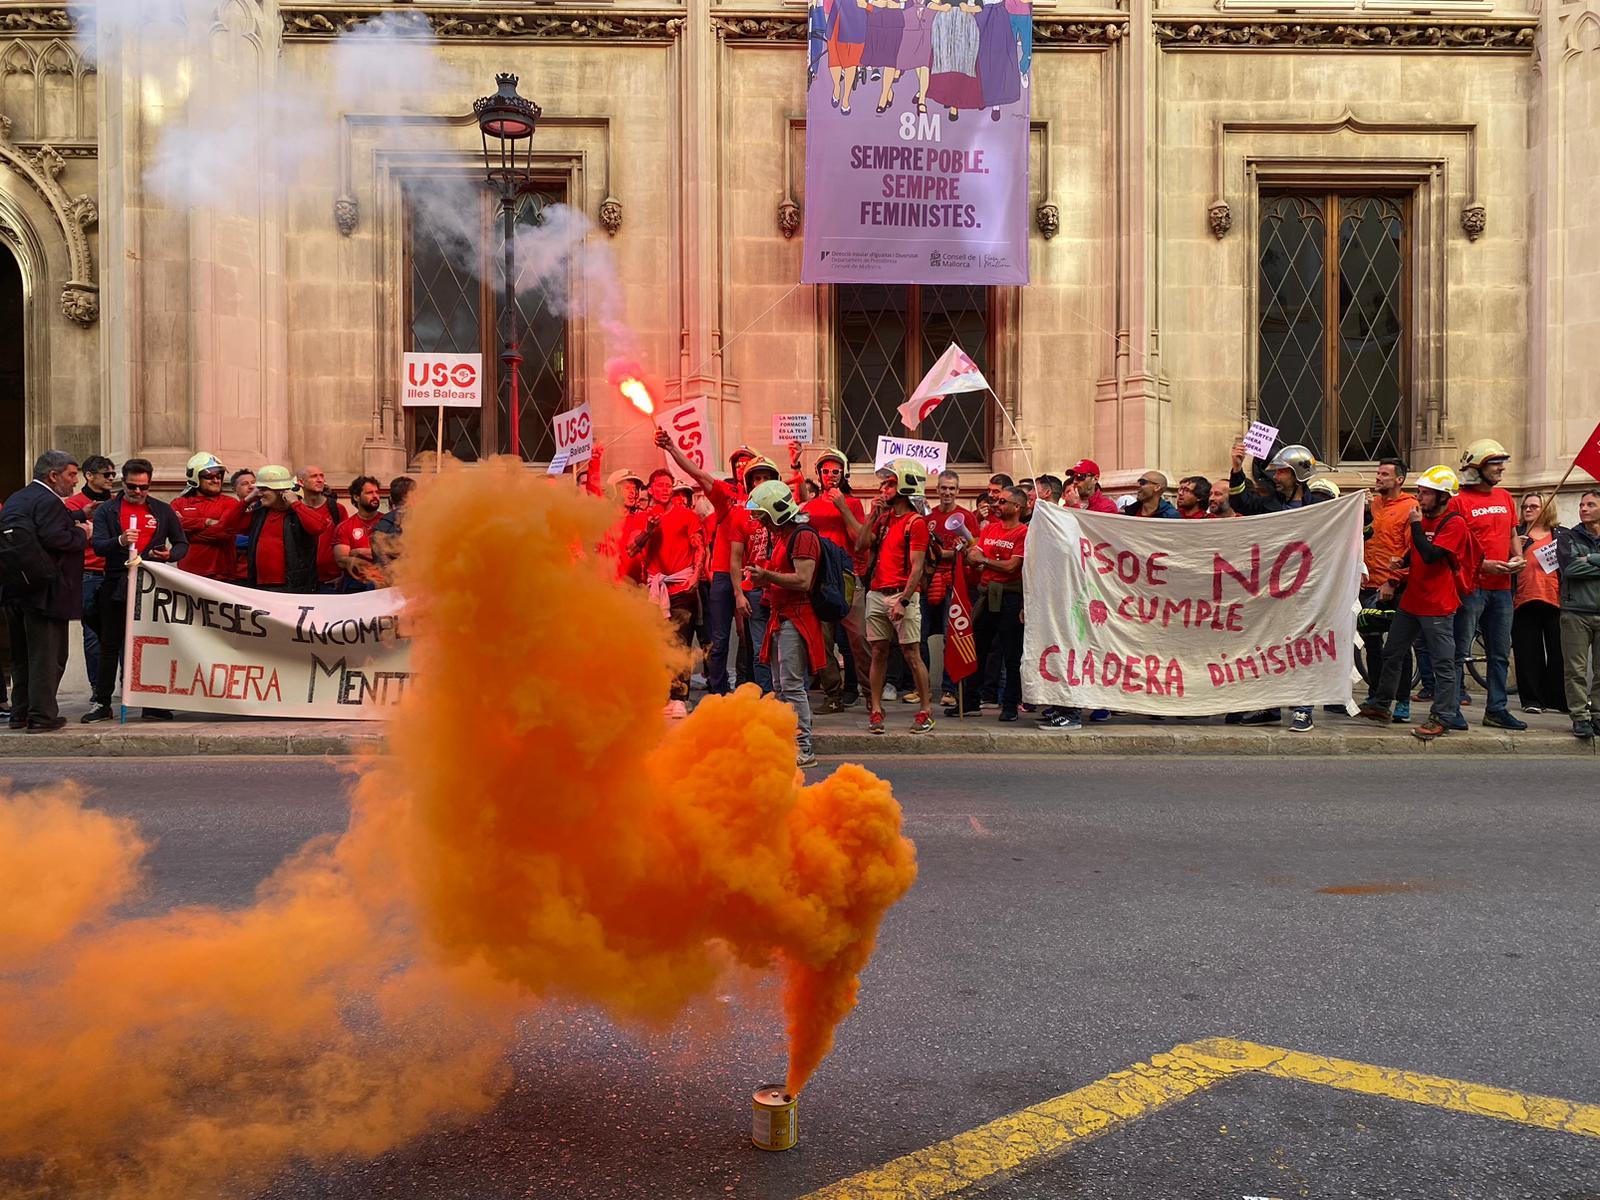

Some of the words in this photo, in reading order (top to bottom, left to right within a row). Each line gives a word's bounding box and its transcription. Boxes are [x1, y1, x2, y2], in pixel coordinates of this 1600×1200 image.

[899, 112, 941, 142] 8M
[850, 145, 923, 171] SEMPRE
[926, 149, 989, 174] POBLE.
[882, 174, 960, 200] SEMPRE
[860, 201, 981, 228] FEMINISTES.
[942, 253, 966, 261] Consell
[942, 260, 970, 268] Mallorca
[409, 362, 476, 388] USO
[407, 389, 430, 398] Illes
[433, 389, 476, 399] Balears
[557, 412, 590, 448] USO
[881, 439, 904, 455] TONI
[906, 443, 941, 459] ESPASES
[984, 538, 1015, 549] BOMBERS
[1080, 537, 1169, 586] PSOE
[1213, 541, 1313, 603] NO
[134, 567, 270, 637] PROMESES
[1118, 596, 1244, 632] CUMPLE
[130, 636, 282, 702] CLADERA
[1039, 645, 1184, 698] CLADERA
